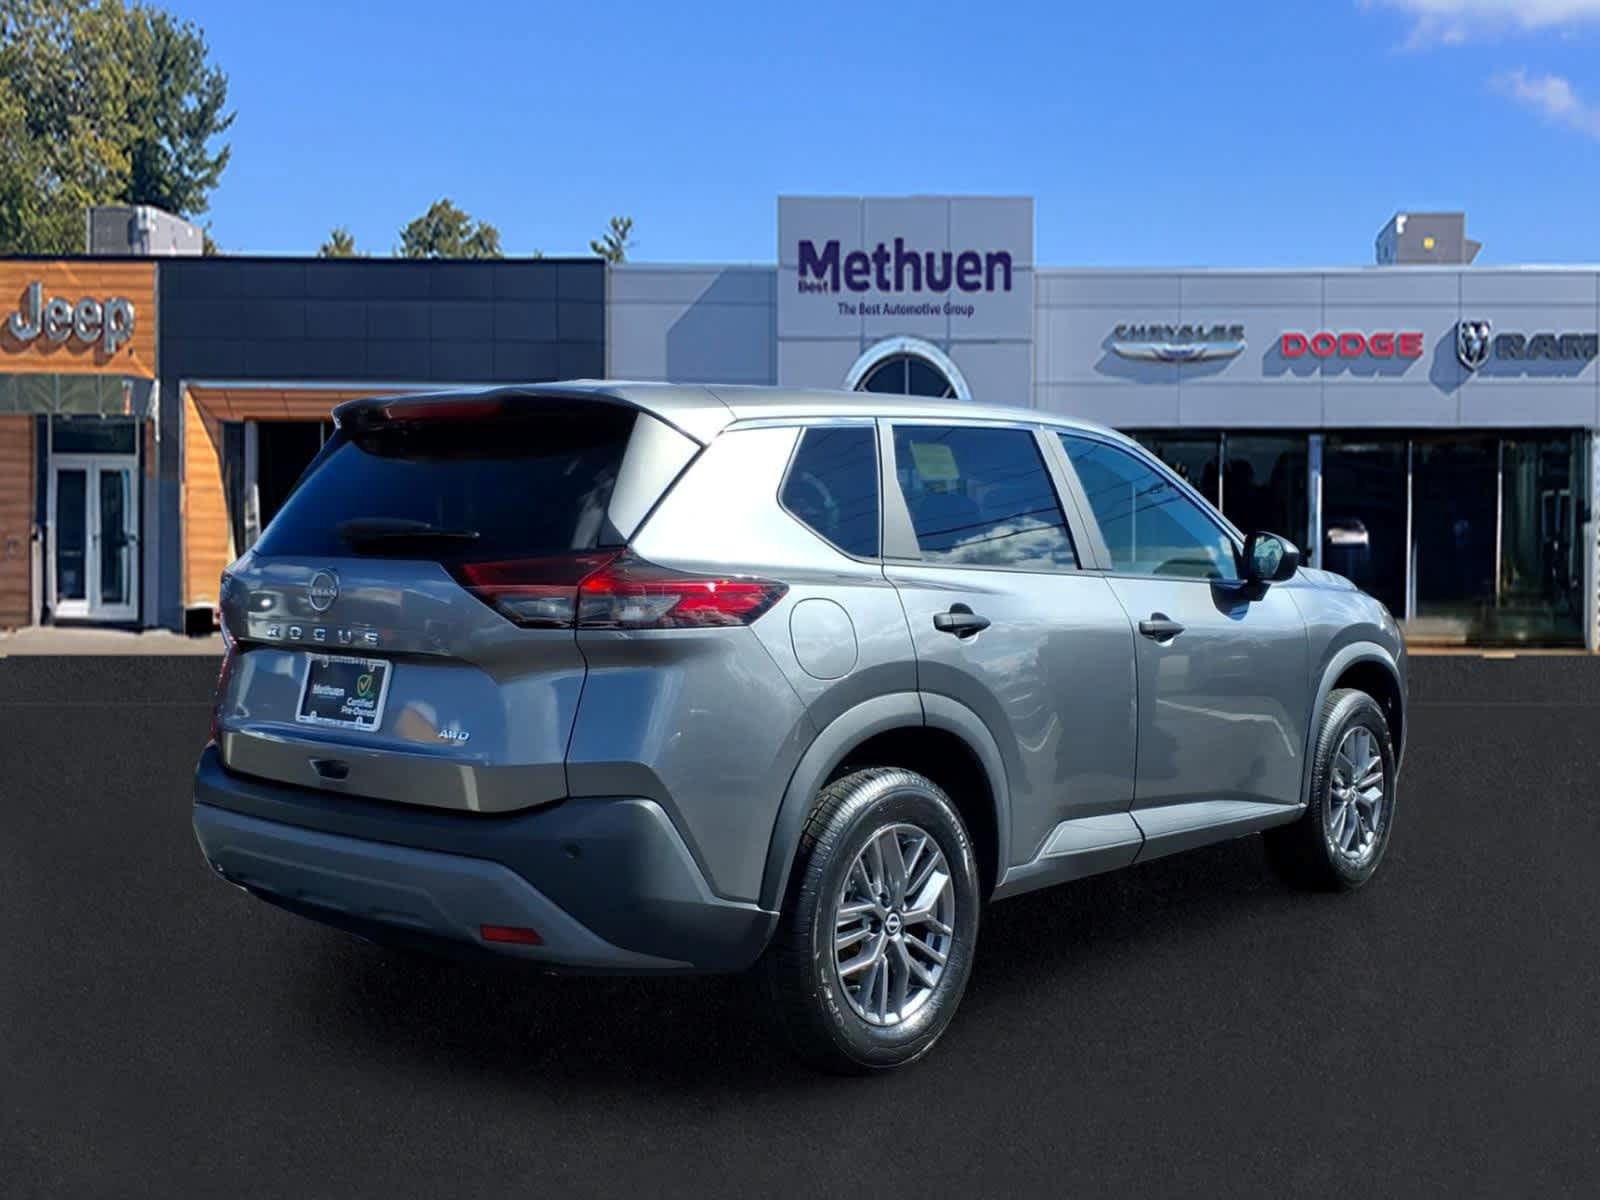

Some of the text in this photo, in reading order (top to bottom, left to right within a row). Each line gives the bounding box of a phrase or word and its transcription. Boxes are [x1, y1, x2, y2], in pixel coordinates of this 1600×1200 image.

[798, 237, 1012, 293] Methuen
[798, 279, 829, 295] Best
[8, 281, 135, 352] Jeep
[838, 302, 975, 318] The Best Automotive Group
[1114, 323, 1245, 341] CHRYSLER
[1282, 332, 1424, 357] DODGE
[1494, 332, 1598, 361] RAM
[438, 729, 470, 741] AWD
